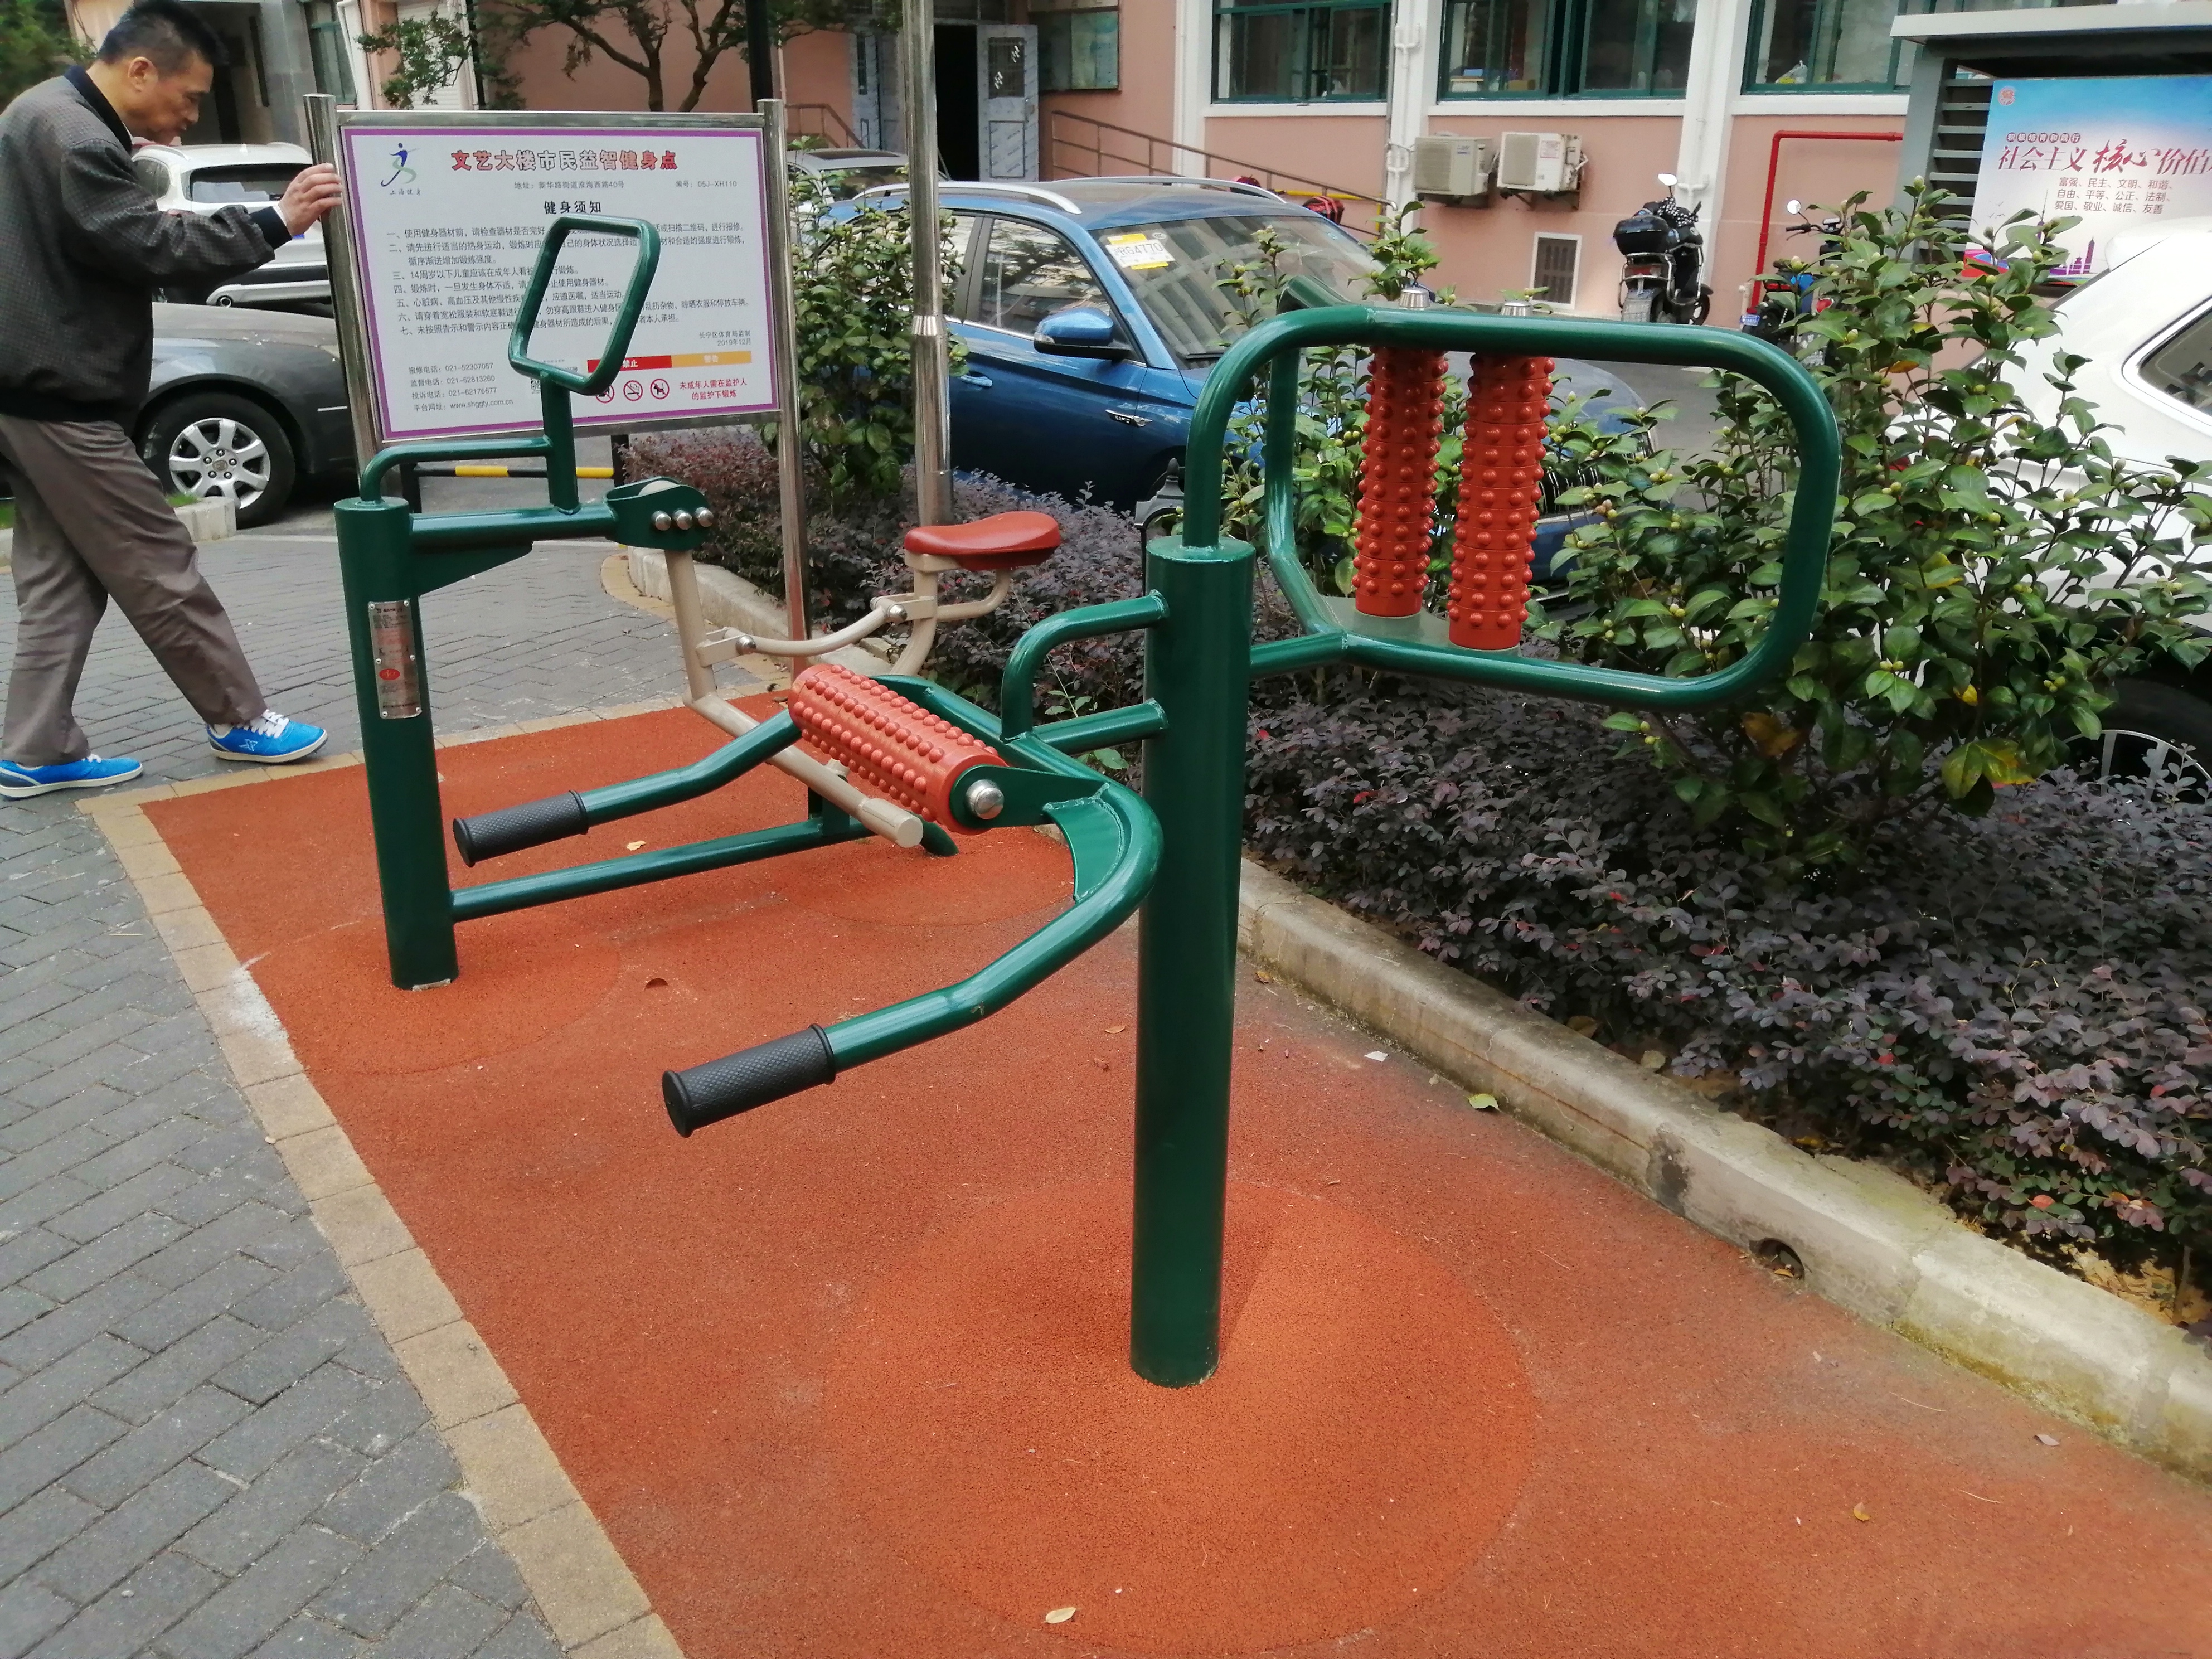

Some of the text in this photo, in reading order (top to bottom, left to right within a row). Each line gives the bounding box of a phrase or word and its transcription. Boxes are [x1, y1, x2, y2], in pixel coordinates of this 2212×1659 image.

[450, 149, 678, 171] 文艺大楼市民益智健身点
[1998, 139, 2212, 175] 社会主义核心价值
[544, 201, 601, 214] 健身须知
[408, 254, 497, 266] 循序渐进增加锻炼强度。
[699, 329, 751, 339] 长宁区体育局监制
[717, 338, 751, 346] 2019年12月
[622, 359, 638, 368] 禁止
[680, 377, 748, 390] 未成年人需在监护人
[692, 389, 737, 400] 的监护下锻炼
